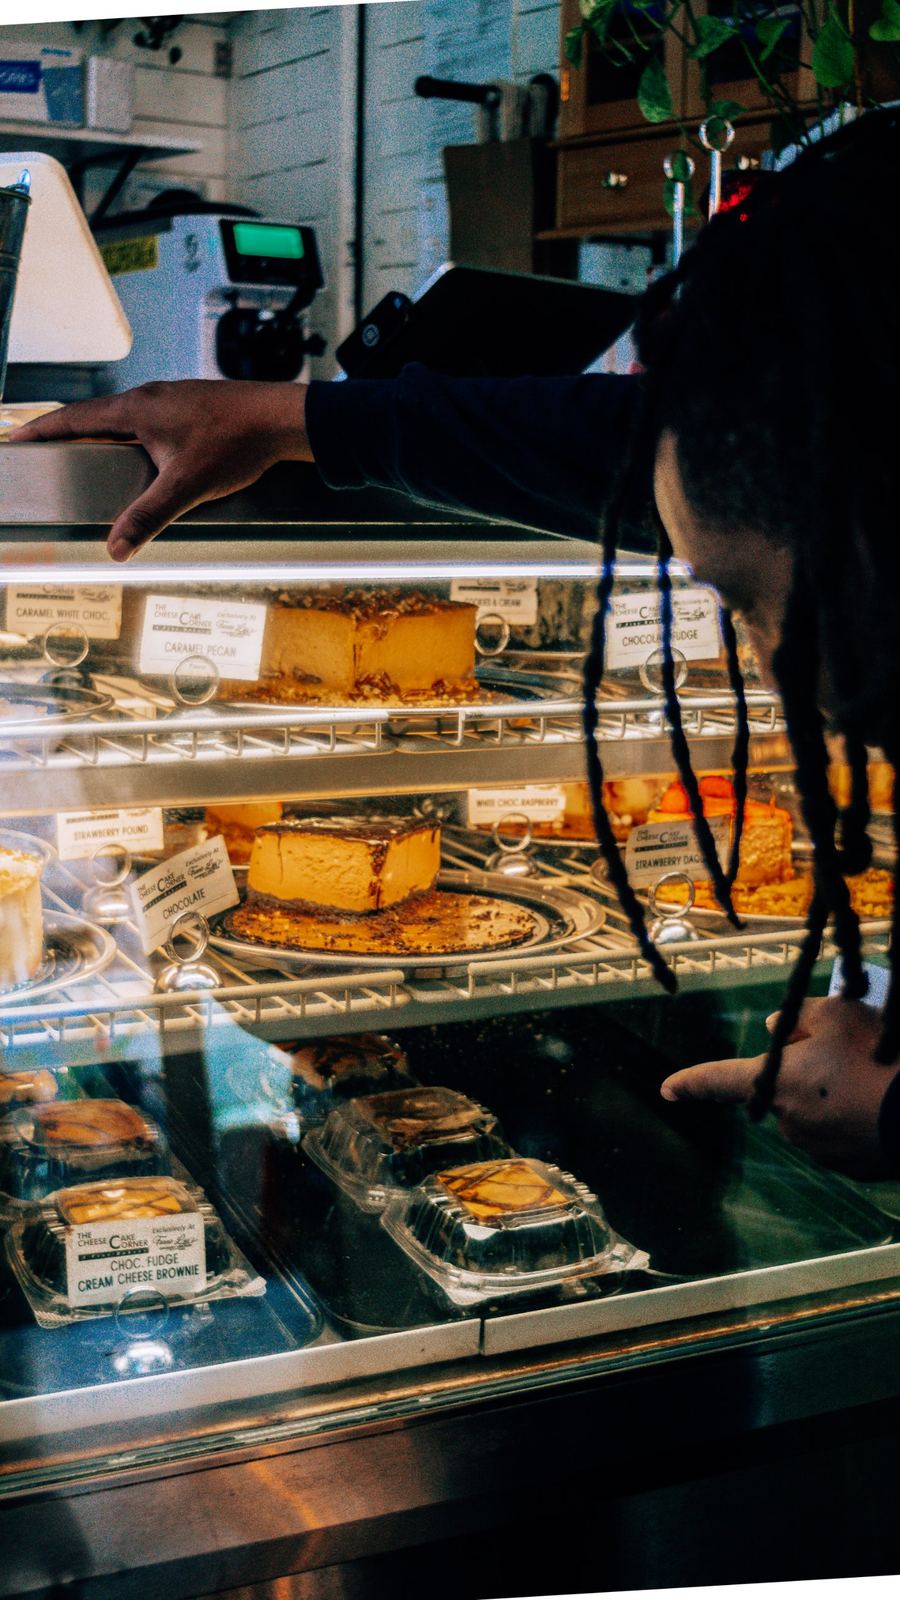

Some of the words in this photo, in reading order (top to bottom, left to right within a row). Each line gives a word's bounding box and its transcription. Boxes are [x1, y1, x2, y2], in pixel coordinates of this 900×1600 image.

[16, 607, 54, 619] CARAMEL
[56, 609, 80, 620] WHITE
[164, 641, 204, 654] CARAMEL
[206, 645, 237, 657] PECAN
[74, 827, 120, 841] STRAWBERRY
[122, 824, 149, 836] POUND
[635, 856, 681, 870] STRAWBERRY
[162, 887, 206, 920] CHOCOLATE
[77, 1231, 92, 1240] THE
[77, 1237, 107, 1248] CHEESE
[110, 1257, 145, 1272] CHOC.
[147, 1252, 179, 1267] FUDGE
[77, 1275, 114, 1293] CREAM
[117, 1269, 154, 1285] CHEESE
[156, 1264, 200, 1281] BROWNIE
